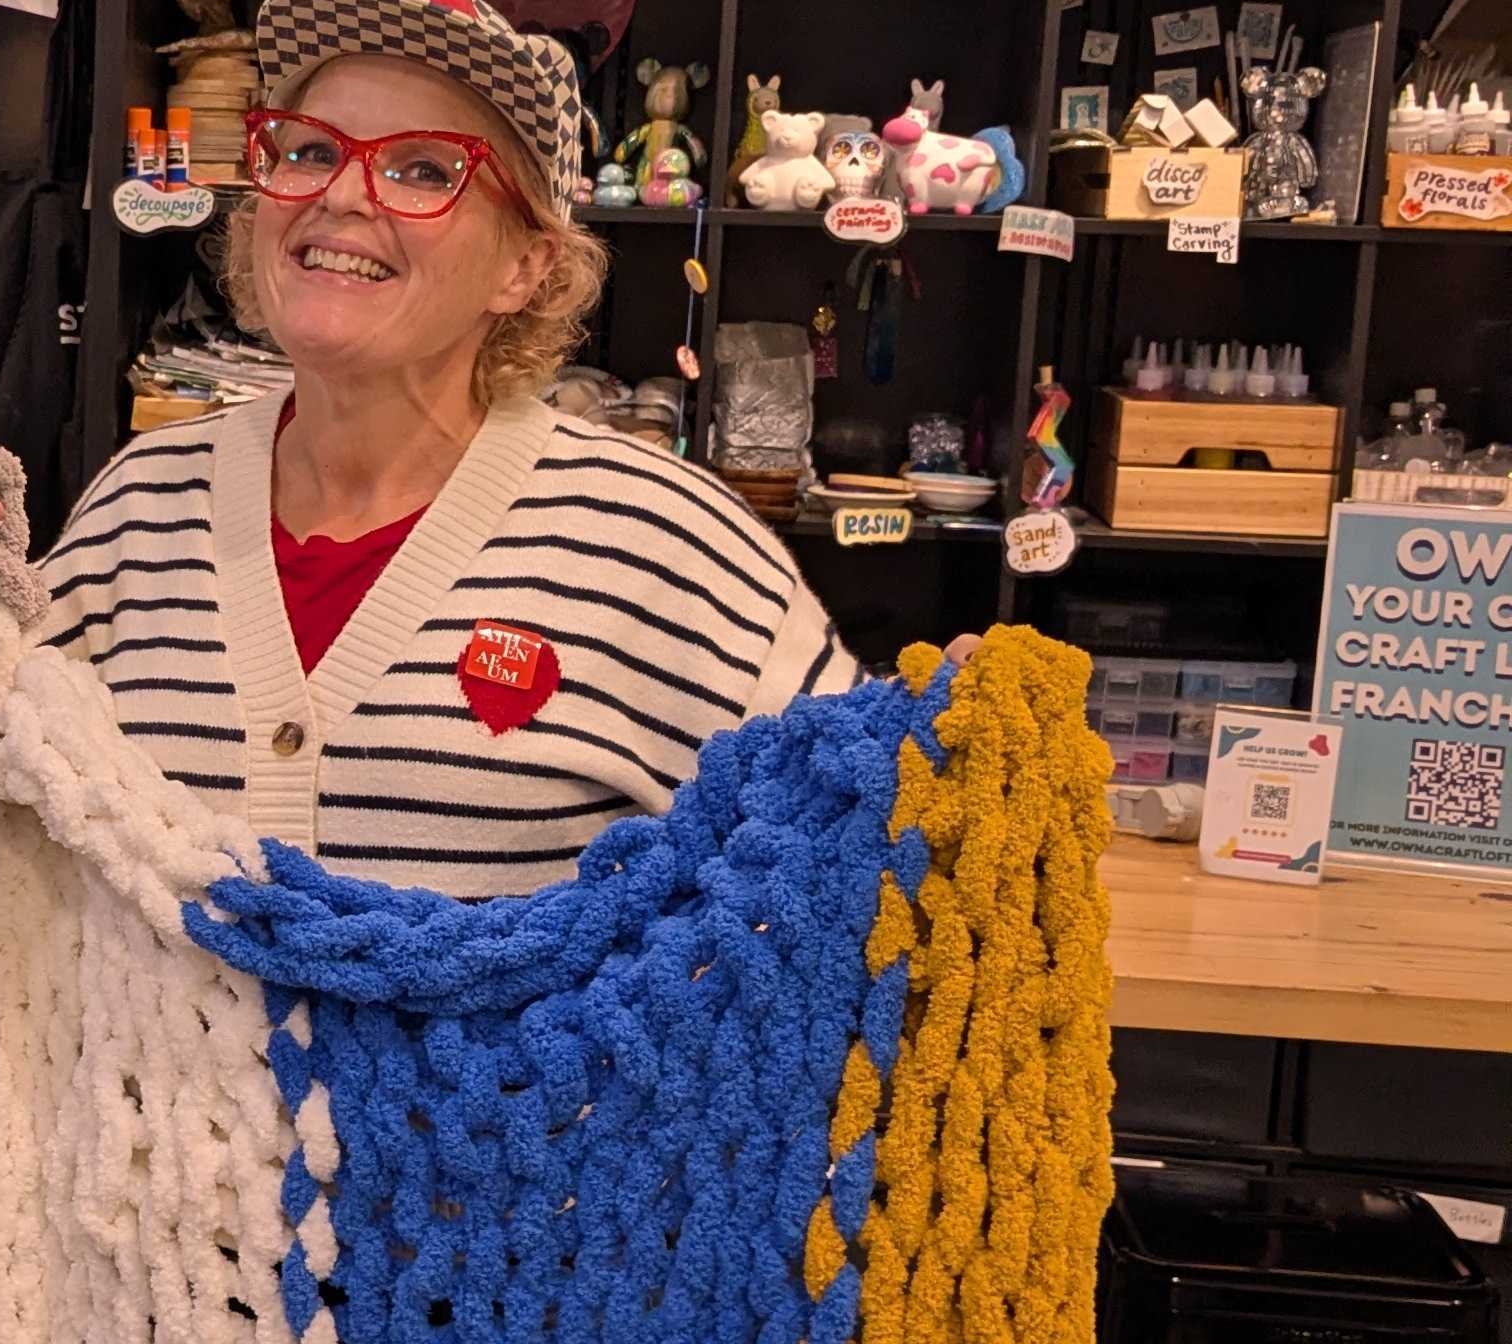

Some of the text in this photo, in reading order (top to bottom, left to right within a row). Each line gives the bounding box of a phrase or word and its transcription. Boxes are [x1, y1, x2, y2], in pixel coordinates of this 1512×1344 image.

[1147, 159, 1206, 184] disco
[1413, 170, 1493, 194] pressed
[1155, 184, 1195, 200] art
[1422, 188, 1488, 211] florals
[129, 194, 206, 217] decoupage
[836, 202, 886, 217] ceramic
[836, 217, 892, 233] painting
[1172, 237, 1234, 262] Carving
[1013, 517, 1057, 545] sand
[1020, 542, 1049, 562] art
[1346, 584, 1474, 627] YOUR
[1335, 631, 1486, 676] CRAFT
[1330, 821, 1345, 830] OR
[1347, 823, 1380, 834] MORE
[1383, 826, 1466, 842] INFORMATION
[1469, 834, 1500, 846] VISIT
